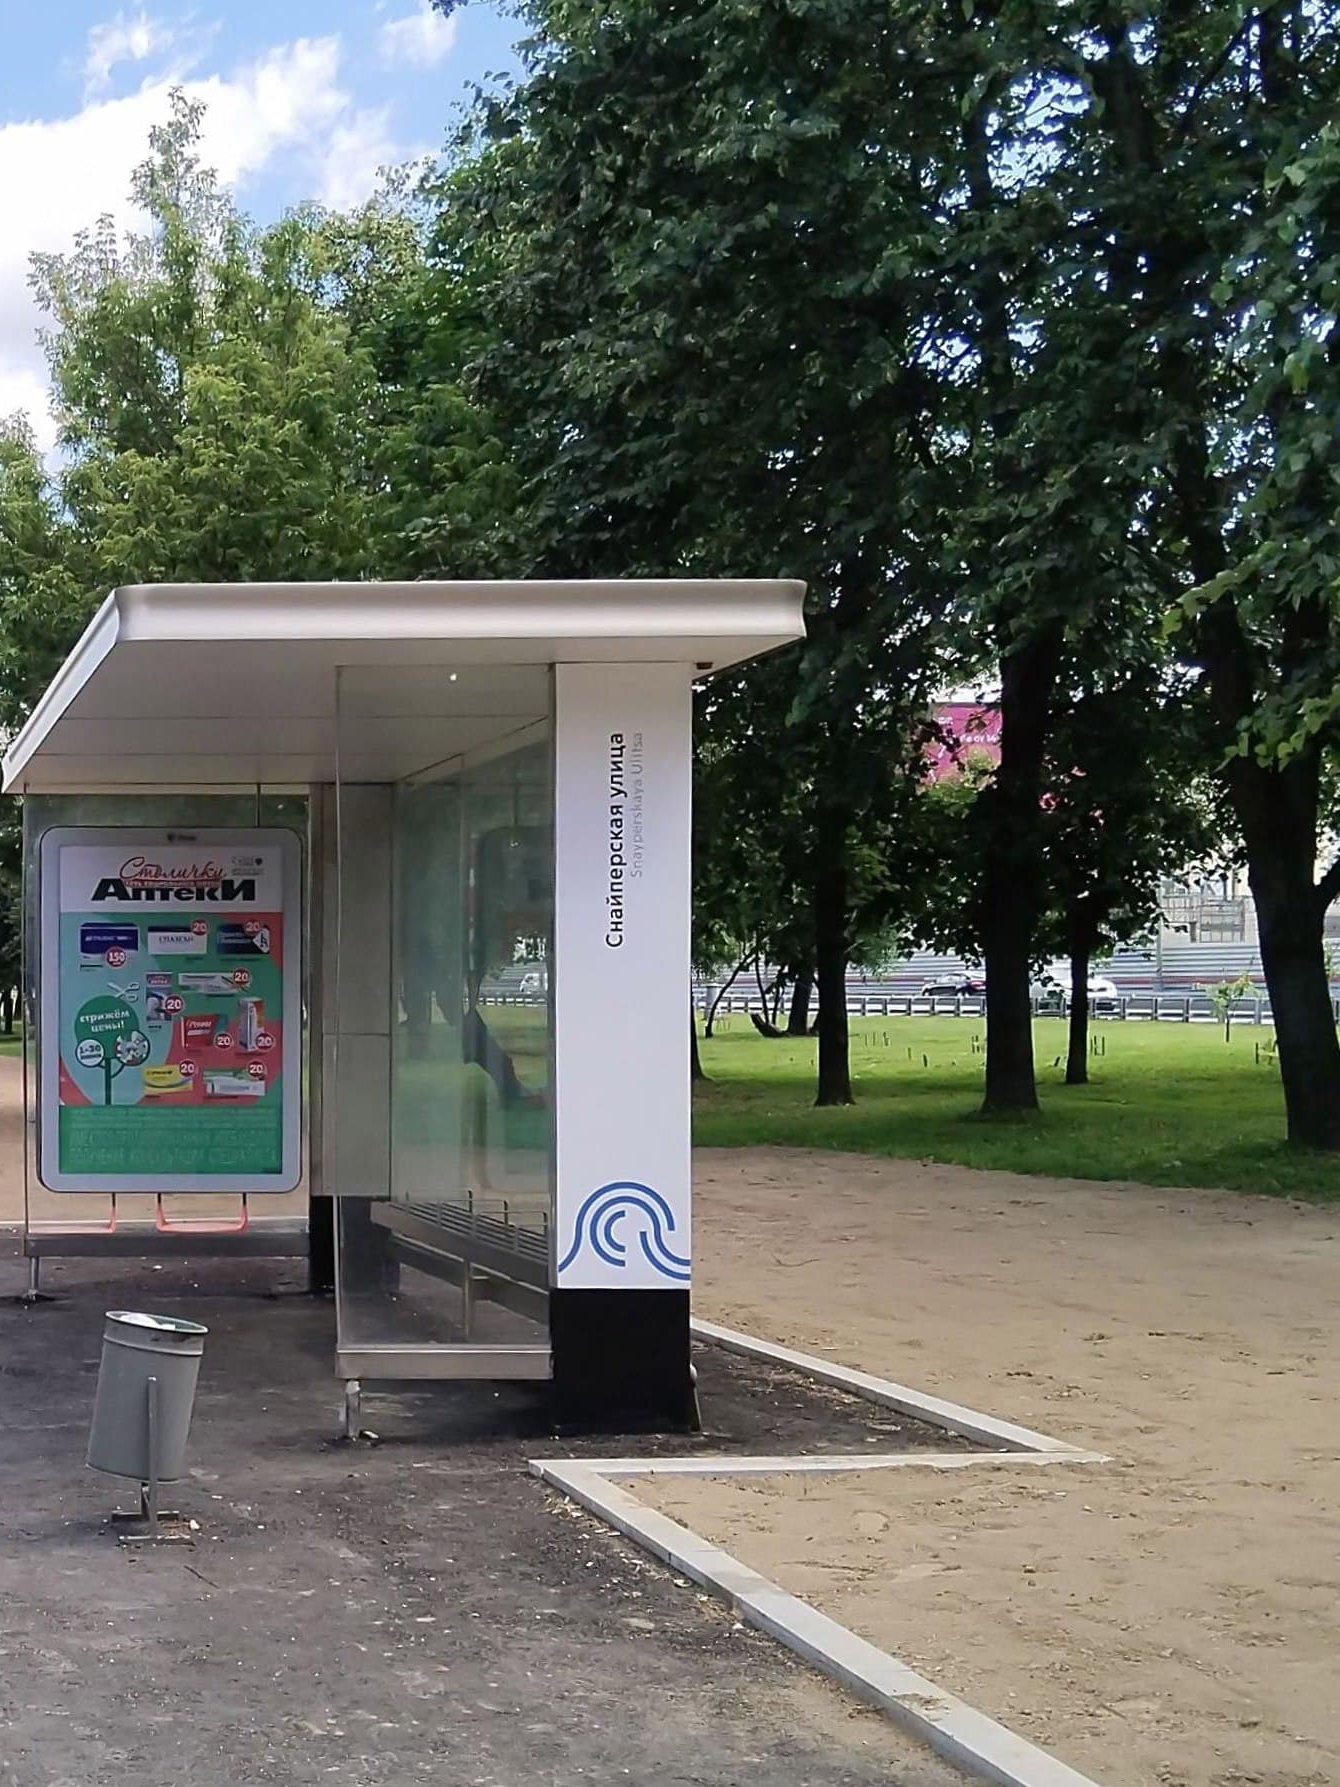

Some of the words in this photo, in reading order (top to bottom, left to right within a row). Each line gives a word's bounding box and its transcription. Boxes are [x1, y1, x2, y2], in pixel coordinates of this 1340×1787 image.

[630, 732, 643, 775] Ulitsa
[611, 733, 627, 798] улица
[630, 778, 644, 878] Snayperskaya
[119, 856, 228, 880] Столички
[605, 804, 627, 948] Снайперская
[192, 922, 207, 932] 20
[245, 922, 260, 932] 20
[234, 972, 249, 982] 20
[166, 999, 181, 1010] 20
[217, 1036, 231, 1046] 20
[257, 1036, 272, 1047] 20
[180, 1063, 194, 1073] 20
[249, 1064, 263, 1074] 20
